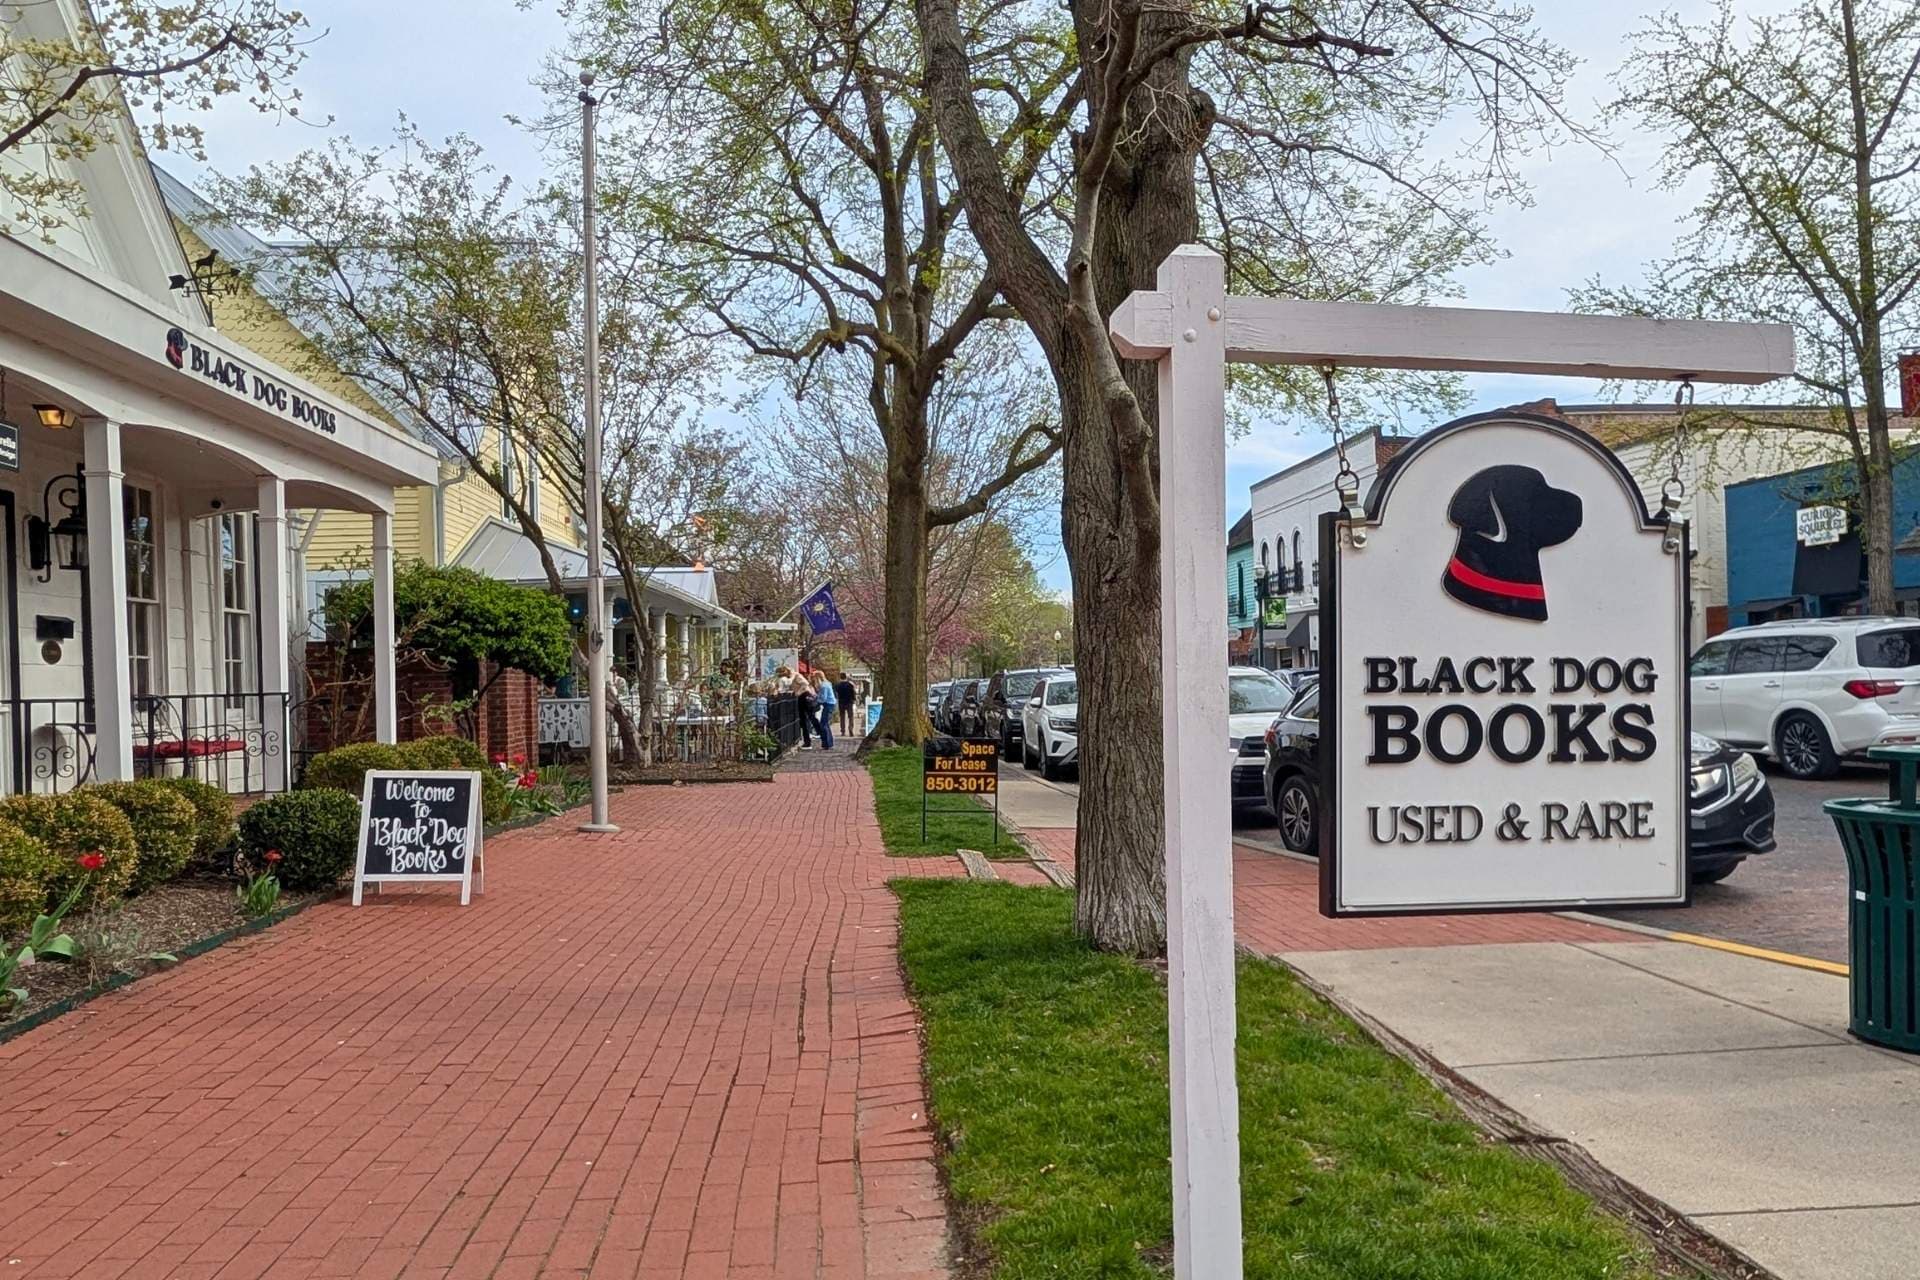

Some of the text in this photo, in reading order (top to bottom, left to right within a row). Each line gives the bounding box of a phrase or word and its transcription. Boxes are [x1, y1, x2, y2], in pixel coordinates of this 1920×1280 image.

[190, 343, 336, 434] BLACK DOG BOOKS
[1799, 518, 1845, 536] SQUIRREL
[1800, 508, 1841, 523] CURIOUS
[1365, 656, 1659, 695] BLACK DOG
[1366, 703, 1657, 764] BOOKS
[962, 742, 995, 757] Space
[935, 757, 987, 770] For Lease
[386, 779, 455, 802] Welcome
[926, 777, 996, 791] 850-3012
[1367, 801, 1656, 844] USED & RARE
[370, 817, 467, 860] Black Dog
[386, 843, 447, 873] Books
